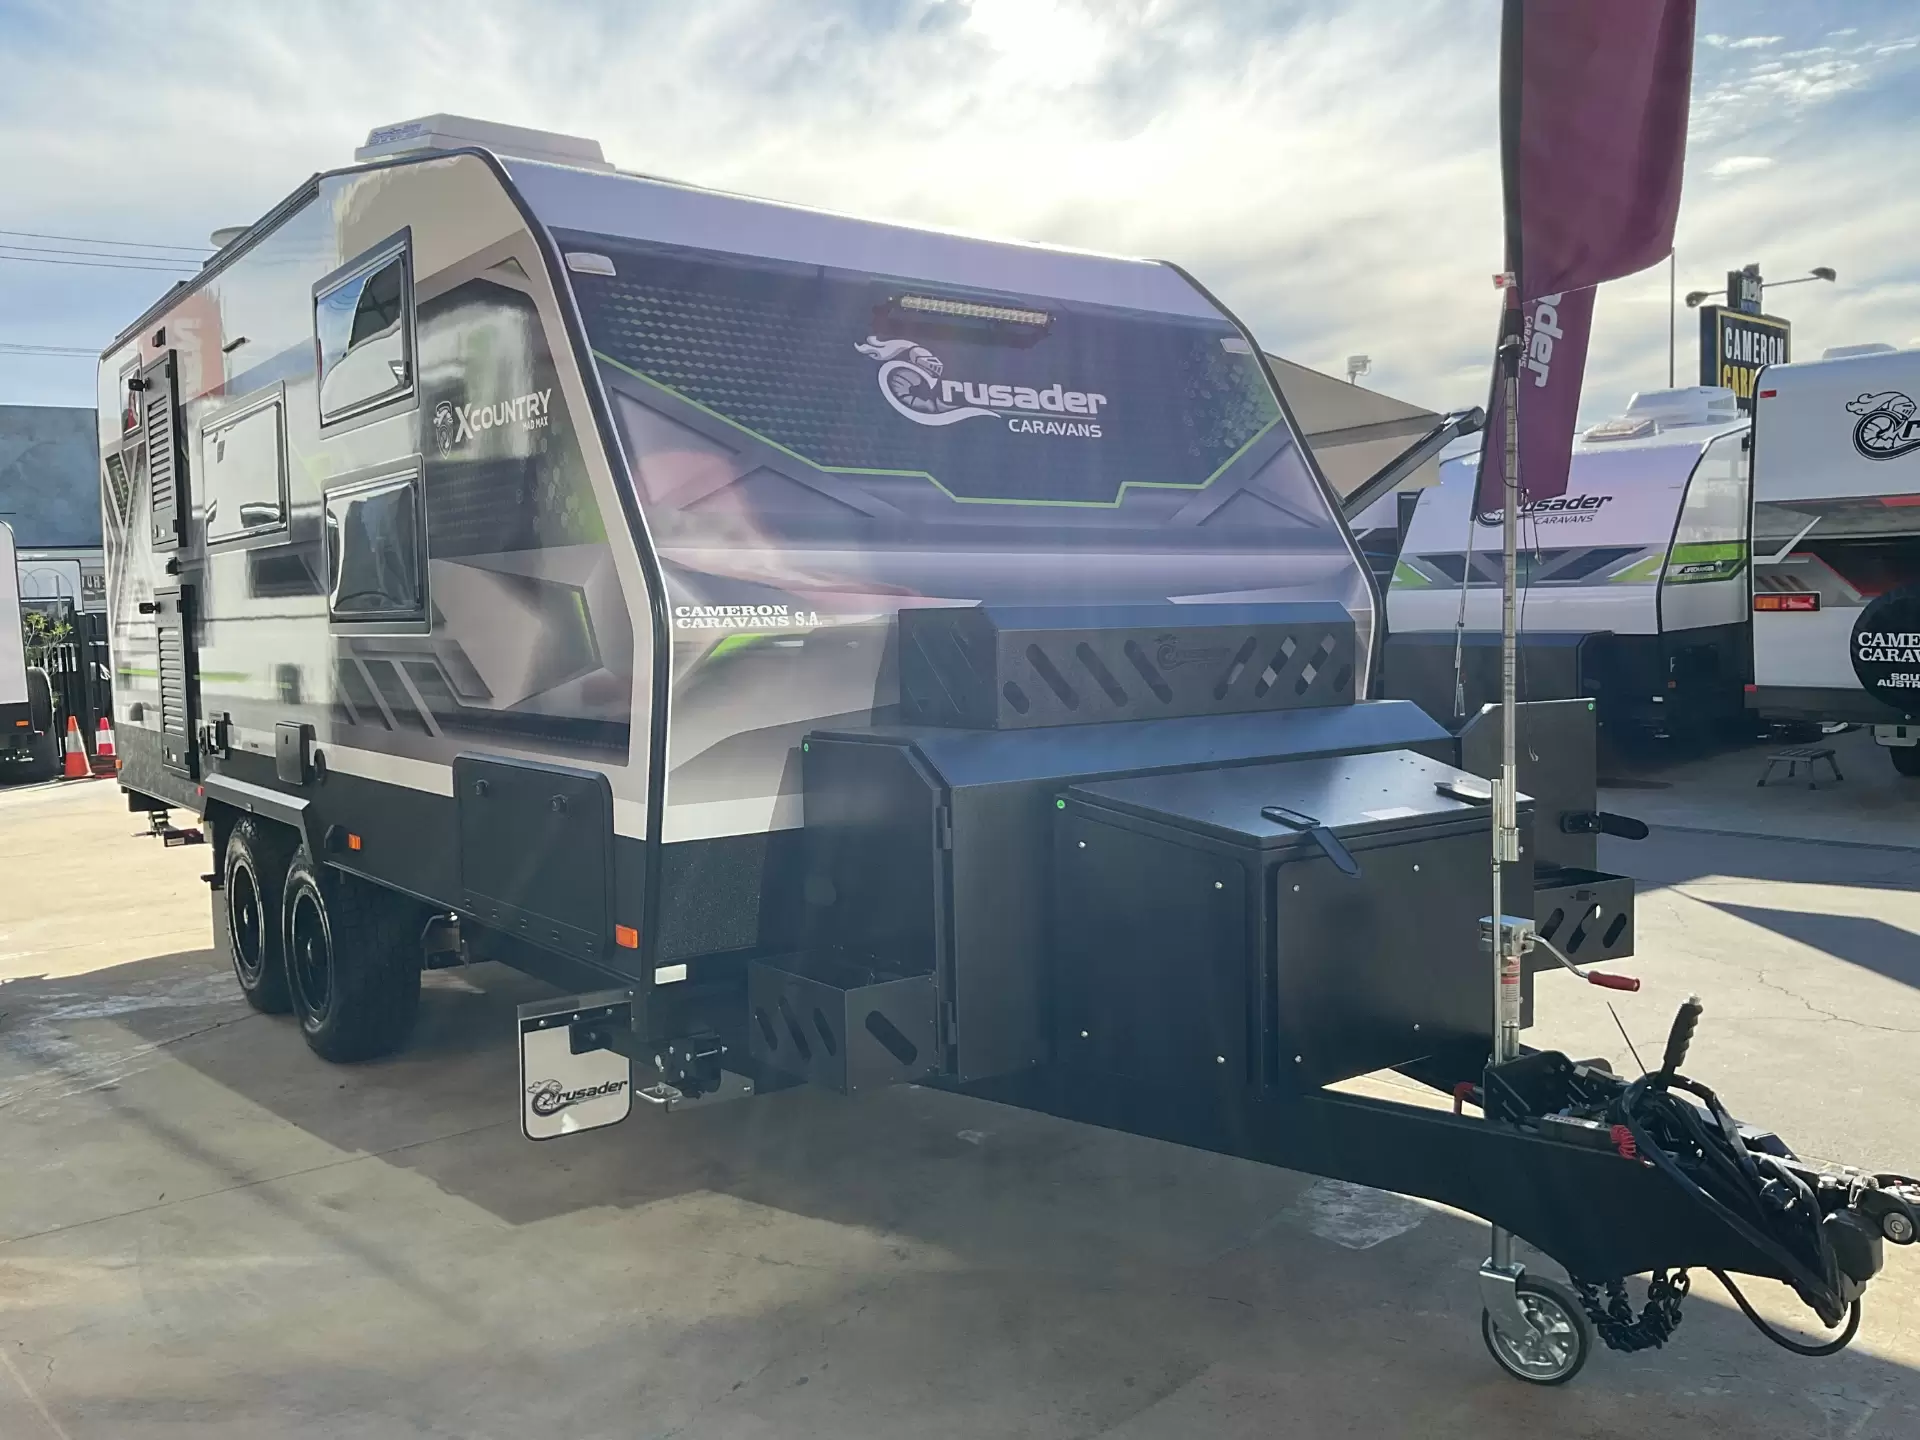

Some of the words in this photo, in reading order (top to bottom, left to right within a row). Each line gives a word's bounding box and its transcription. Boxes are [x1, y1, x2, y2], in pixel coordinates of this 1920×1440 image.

[1724, 326, 1785, 365] CAMERON
[878, 360, 1107, 426] Crusader
[455, 388, 551, 443] XCOUNTRY
[522, 419, 535, 432] MAD
[535, 415, 548, 429] MAX
[1008, 418, 1103, 437] CARAVANS
[1535, 514, 1595, 525] CARAVANS
[675, 605, 788, 617] CAMERON
[676, 616, 790, 629] CARAVANS
[794, 611, 823, 627] S.A.
[1858, 631, 1920, 648] CAME
[1890, 672, 1920, 681] SOU
[531, 1080, 628, 1118] Crusader
